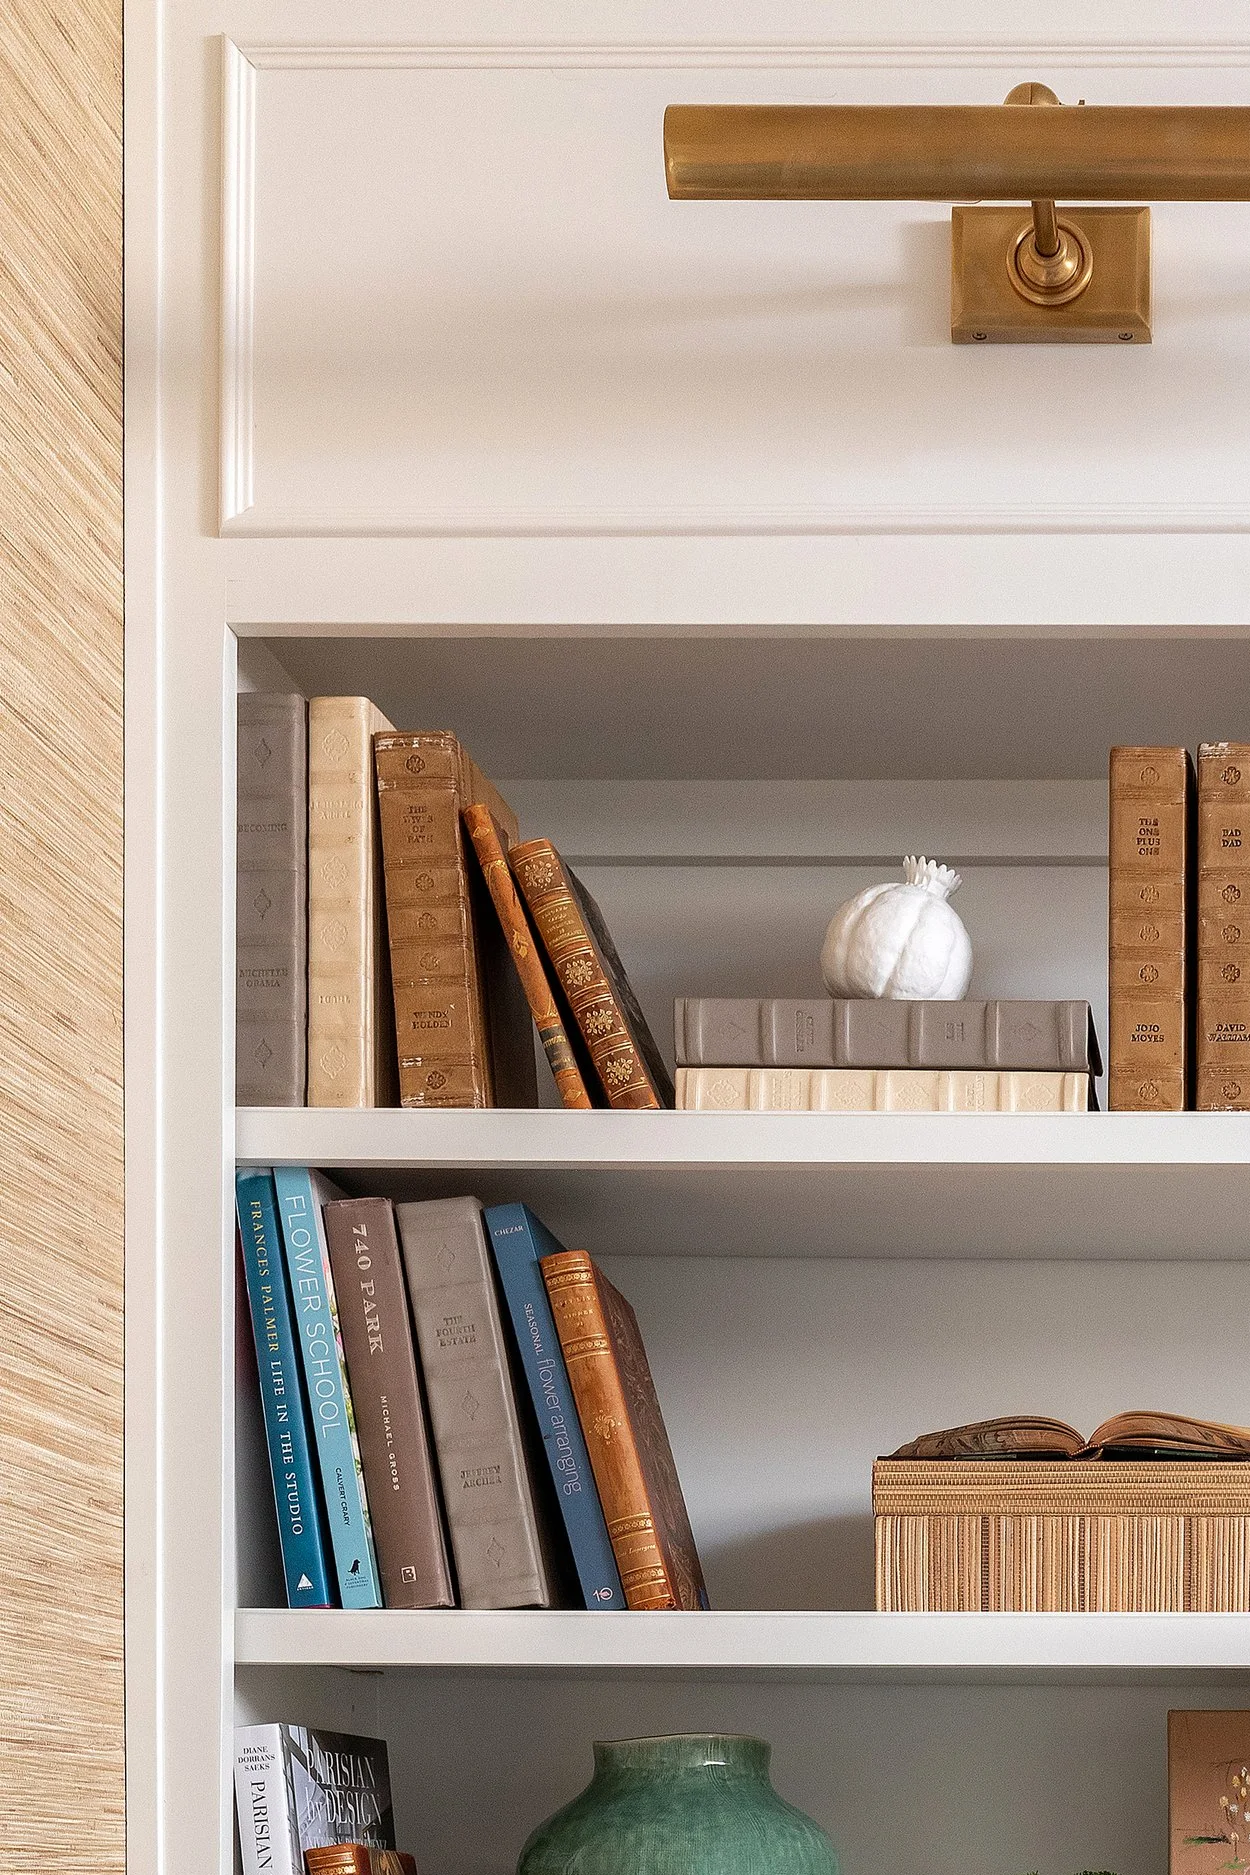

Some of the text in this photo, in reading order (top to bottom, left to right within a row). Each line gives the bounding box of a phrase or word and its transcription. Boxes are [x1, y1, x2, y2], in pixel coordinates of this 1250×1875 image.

[1138, 818, 1159, 826] THE
[238, 823, 288, 833] BECOMING
[1221, 828, 1242, 837] BAD
[1221, 839, 1242, 847] DAD
[1135, 1024, 1160, 1032] JOJO
[1215, 1023, 1247, 1032] DAVID
[1131, 1034, 1165, 1042] MOYES
[494, 1225, 524, 1237] CHEZAR
[352, 1223, 384, 1355] 740 PARK
[285, 1195, 341, 1439] FLOWER SCHOOL
[250, 1200, 303, 1536] FRANCES PALMER LIFE IN THE STUDIO
[523, 1303, 582, 1496] SEASONAL flower arranging
[380, 1395, 400, 1492] MICHAEL GROSS
[335, 1467, 351, 1526] CALVERT CRARY
[243, 1746, 269, 1755] DIANE
[238, 1753, 276, 1763] DORRANS
[244, 1763, 271, 1771] SAEKS
[307, 1748, 377, 1789] PARISIAN
[325, 1788, 382, 1826] DESIGN
[250, 1780, 273, 1869] PARISIAN
